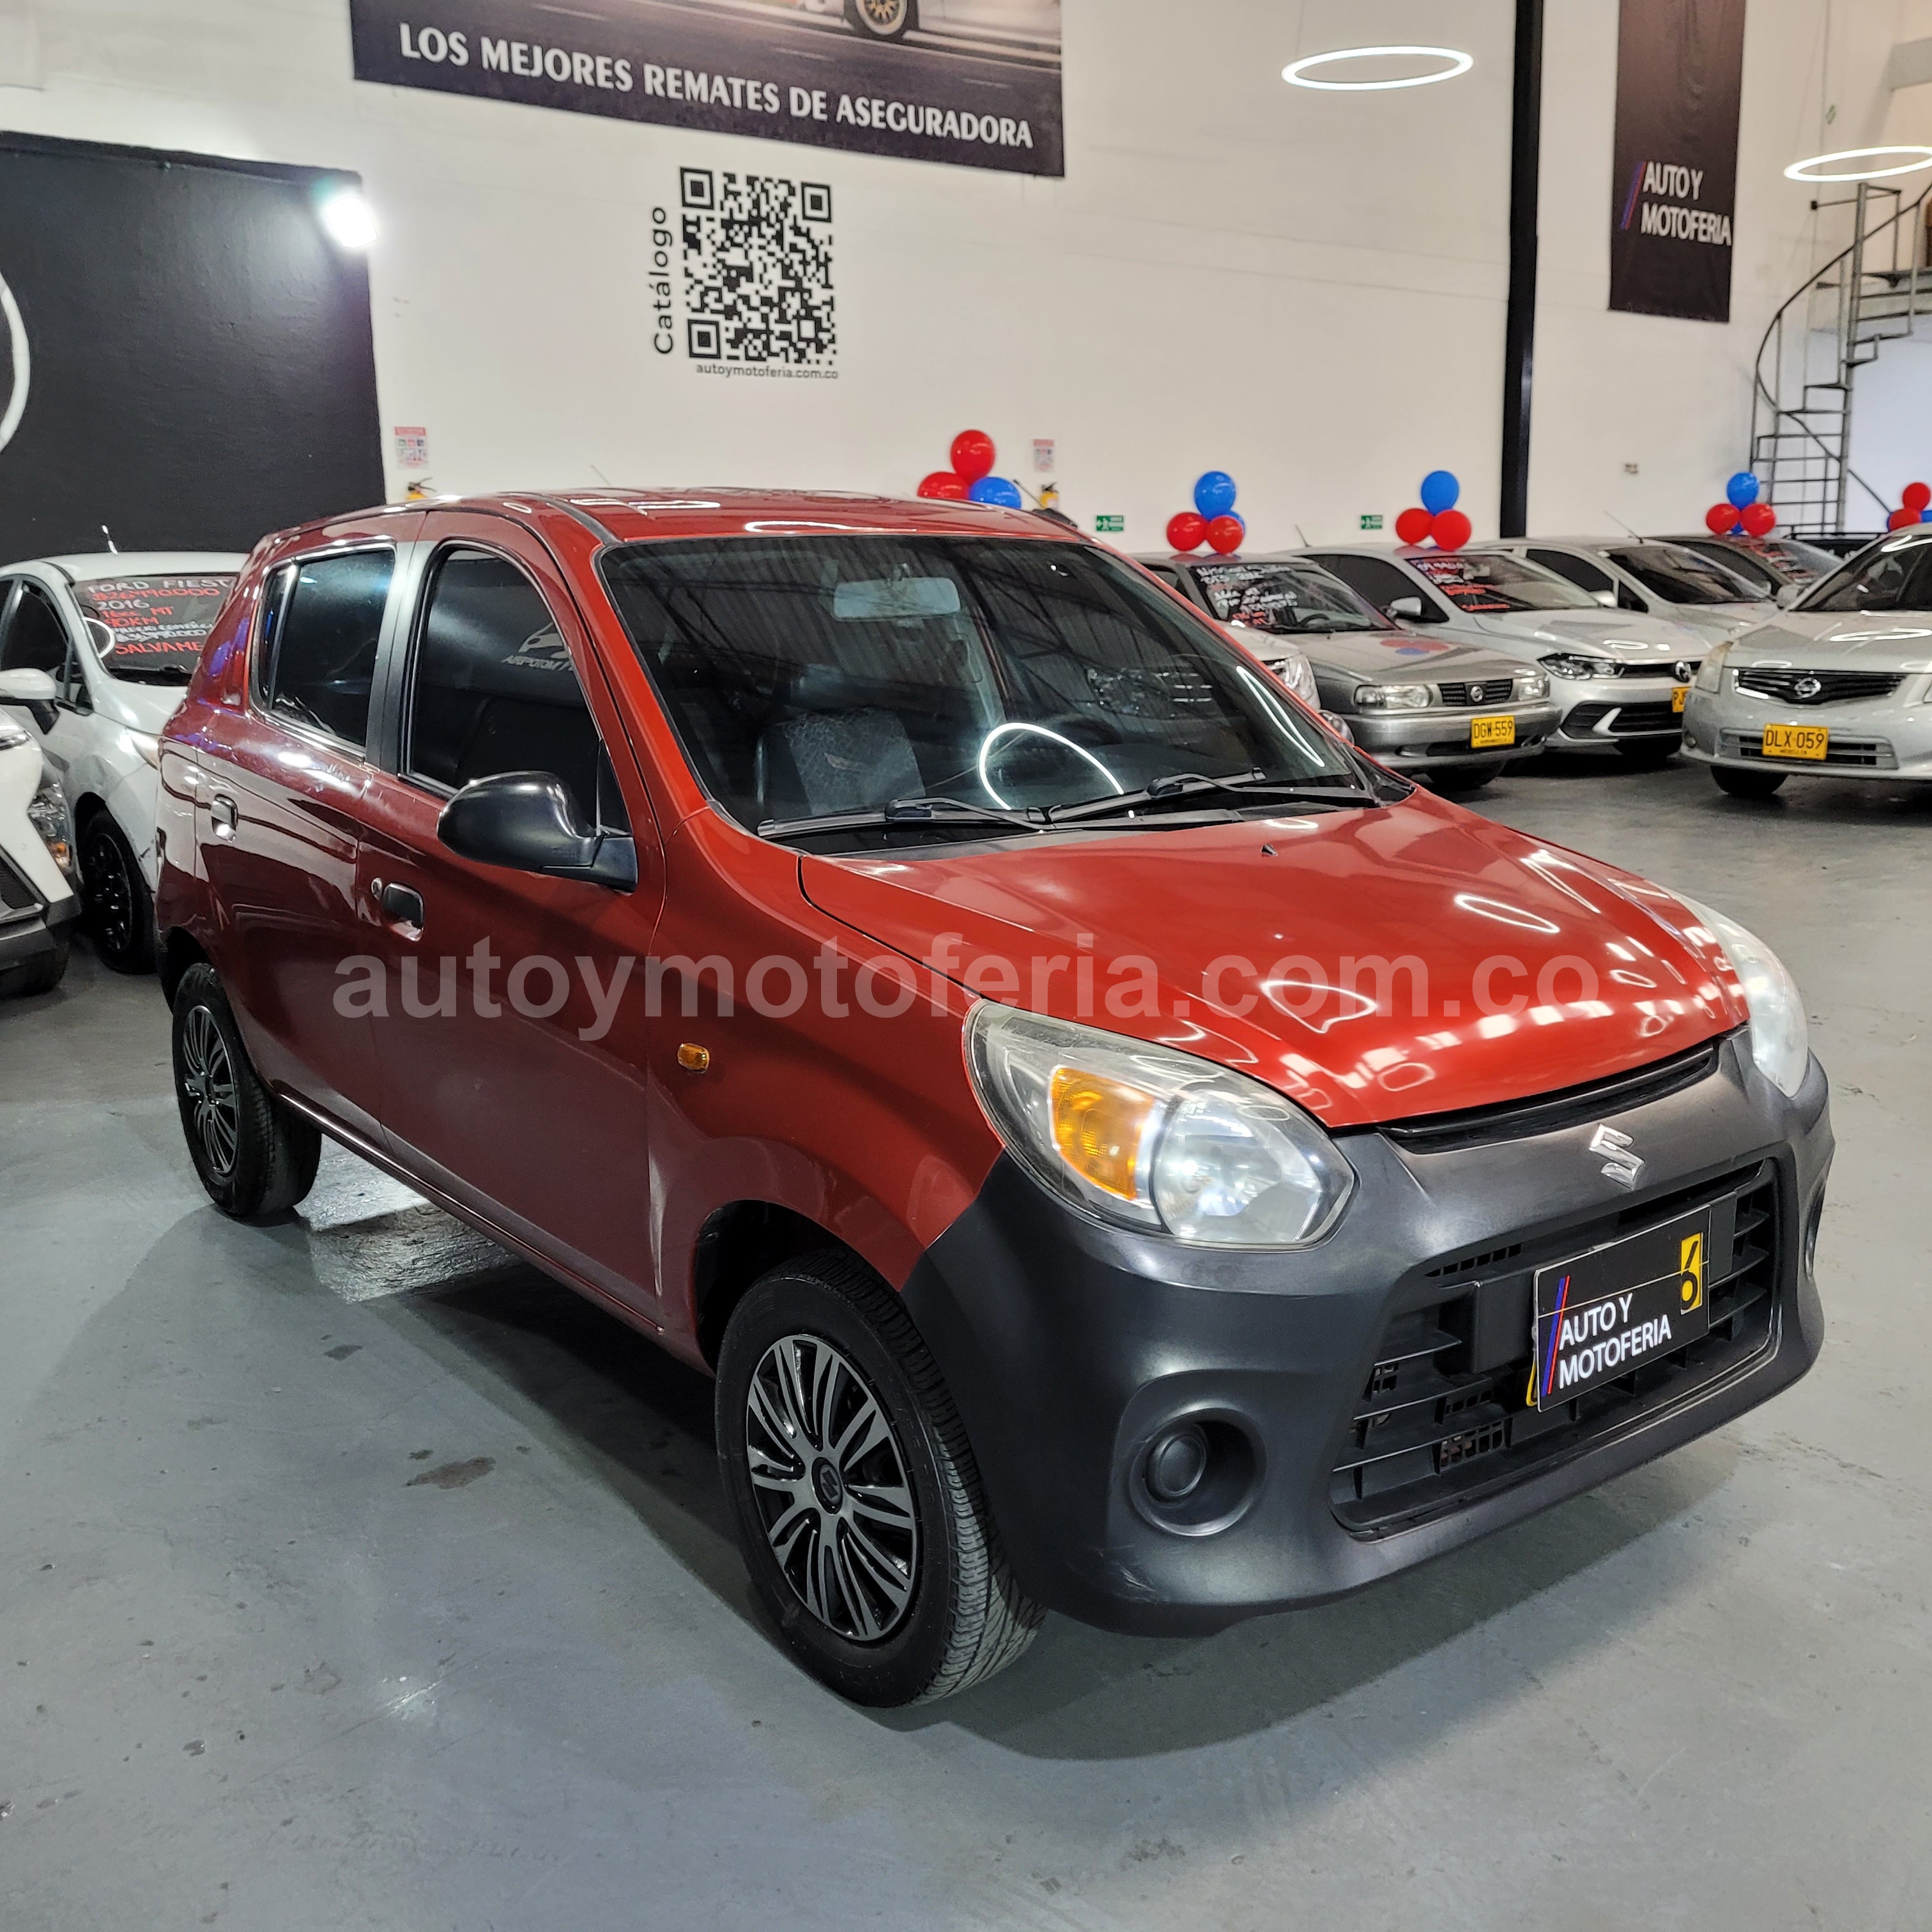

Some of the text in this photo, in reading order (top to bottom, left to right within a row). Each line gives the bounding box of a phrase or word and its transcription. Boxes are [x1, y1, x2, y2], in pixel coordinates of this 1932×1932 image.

[399, 23, 1034, 148] LOS MEJORES REMATES DE ASEGURADORA
[1643, 161, 1704, 201] AUTO Y
[1641, 203, 1732, 246] MOTOFERIA
[648, 206, 673, 355] Catálogo
[696, 363, 838, 379] autoymotoferia.com.co
[88, 580, 150, 594] FORD
[97, 599, 151, 611] 2016
[1765, 730, 1825, 749] DLX 059
[1558, 1292, 1634, 1351] AUTO Y
[1559, 1313, 1673, 1390] MOTOFERIA
